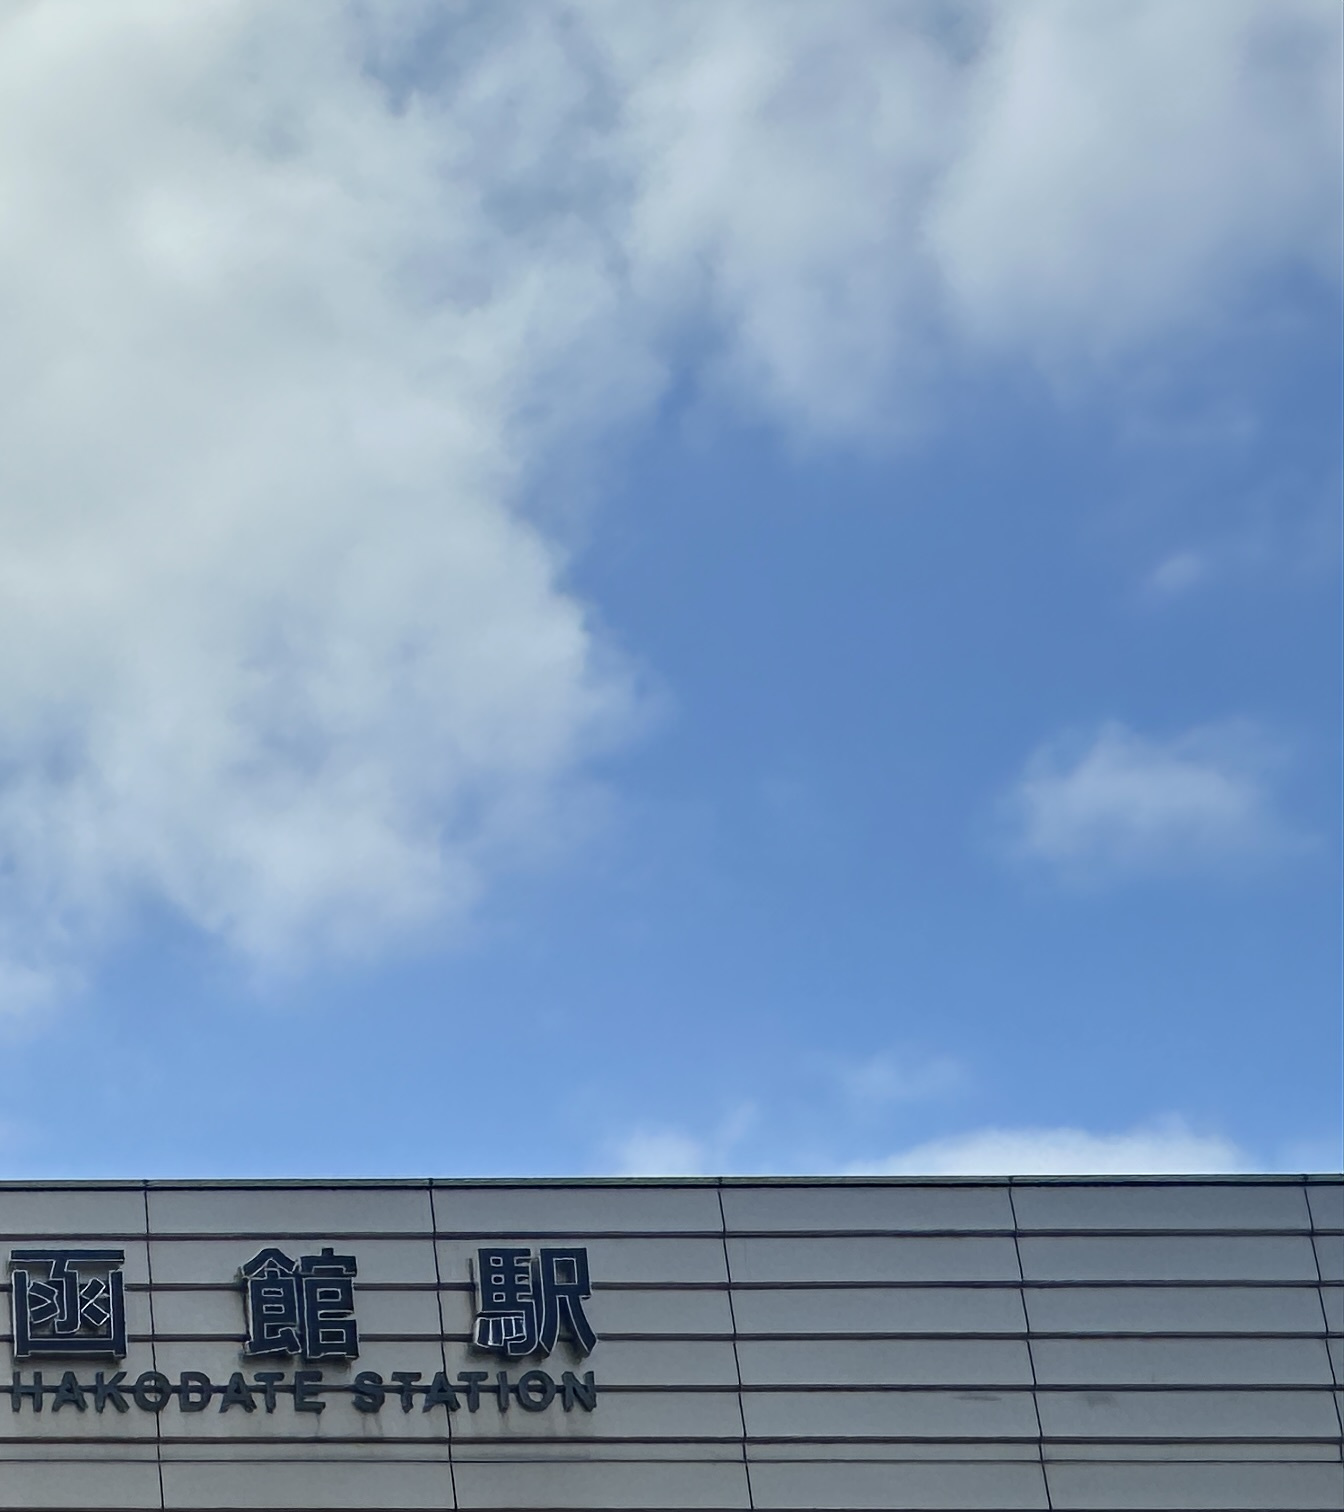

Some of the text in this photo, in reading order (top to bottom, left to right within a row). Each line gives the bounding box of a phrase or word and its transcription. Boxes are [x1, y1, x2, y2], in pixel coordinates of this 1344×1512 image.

[6, 1245, 598, 1361] 函館駅
[9, 1369, 598, 1414] HAKODATE STATION
